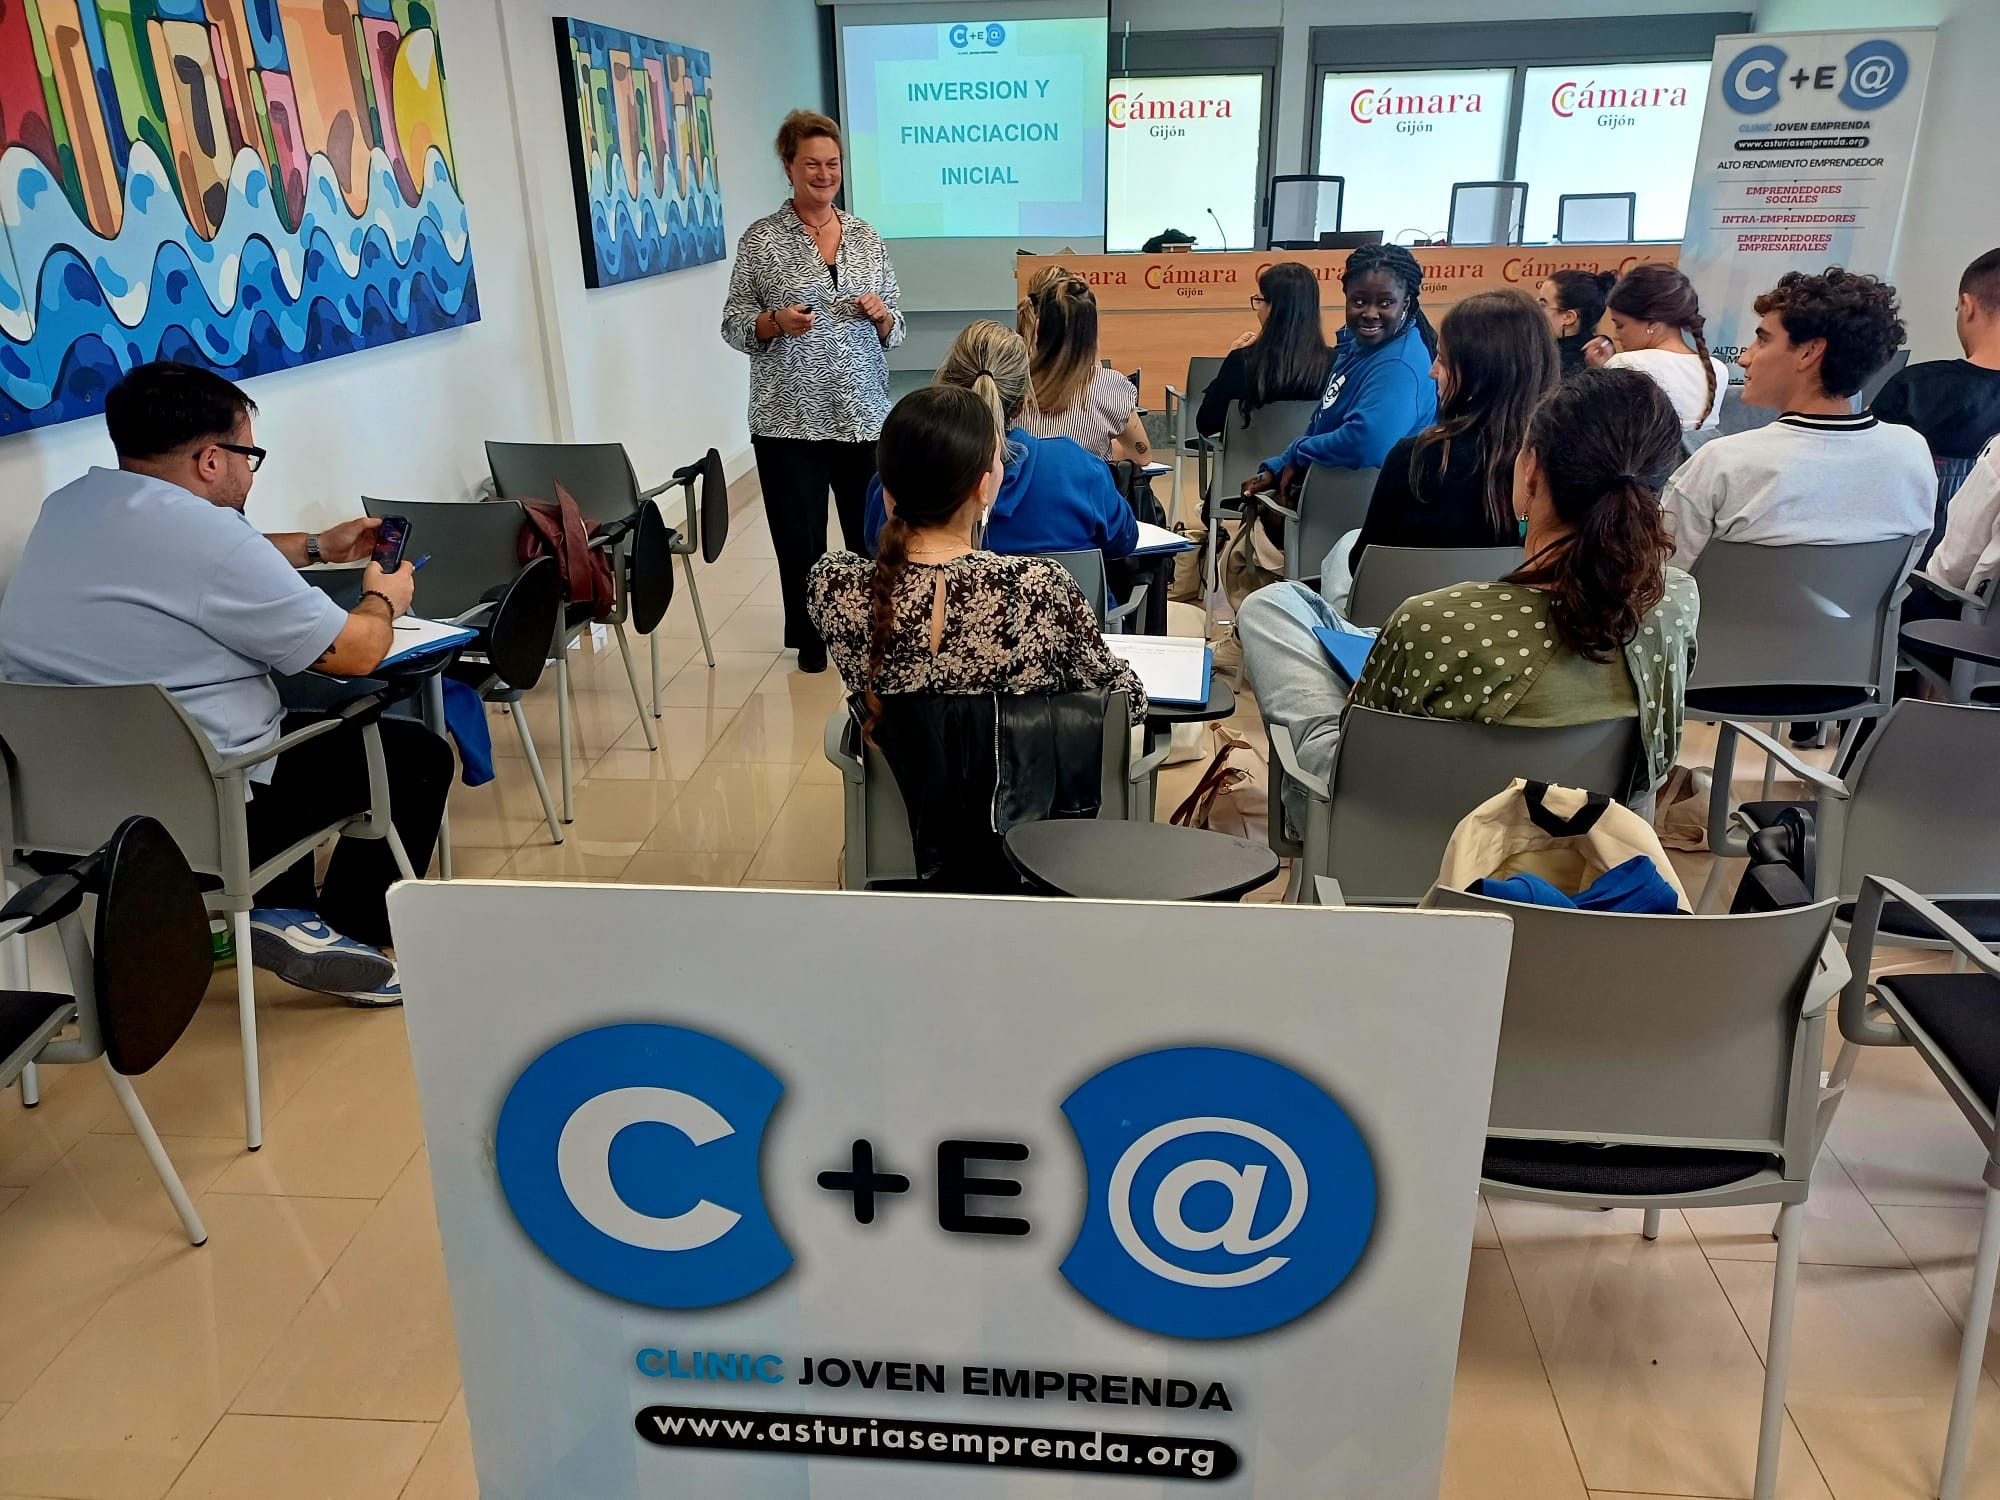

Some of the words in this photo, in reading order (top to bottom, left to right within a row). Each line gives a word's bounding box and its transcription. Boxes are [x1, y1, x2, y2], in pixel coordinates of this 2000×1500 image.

[908, 80, 1028, 101] INVERSION
[1036, 79, 1050, 98] Y
[1350, 87, 1483, 124] Cámara
[1551, 80, 1688, 118] Cámara
[1108, 92, 1232, 128] Cámara
[1396, 120, 1433, 136] Gijón
[1597, 114, 1635, 130] Gijón
[1738, 123, 1773, 133] CLINIC
[1774, 122, 1808, 132] JOVEN
[1810, 121, 1871, 131] EMPRENDA
[900, 122, 1059, 144] FINANCIACION
[1149, 125, 1185, 140] Gijón
[1738, 136, 1866, 150] www.asturiasemprenda.org
[1717, 161, 1741, 170] ALTO
[1742, 159, 1809, 169] RENDIMIENTO
[1809, 158, 1884, 168] EMPRENDEDOR
[941, 166, 1019, 185] INICIAL
[1746, 186, 1842, 195] EMPRENDEDORES
[1765, 195, 1818, 204] SOCIALES
[1722, 215, 1856, 224] INTRA-EMPRENDEDORES
[1737, 234, 1833, 243] EMPRENDEDORES
[1738, 243, 1828, 252] EMPRESARIALES
[1145, 264, 1237, 289] Cámara
[1177, 287, 1203, 298] Gijón
[1421, 282, 1448, 293] Gijón
[1712, 346, 1738, 355] ALTO
[636, 1348, 785, 1384] CLINIC
[798, 1357, 945, 1394] JOVEN
[962, 1366, 1233, 1412] EMPRENDA
[653, 1415, 1215, 1477] www.asturiasemprenda.org
